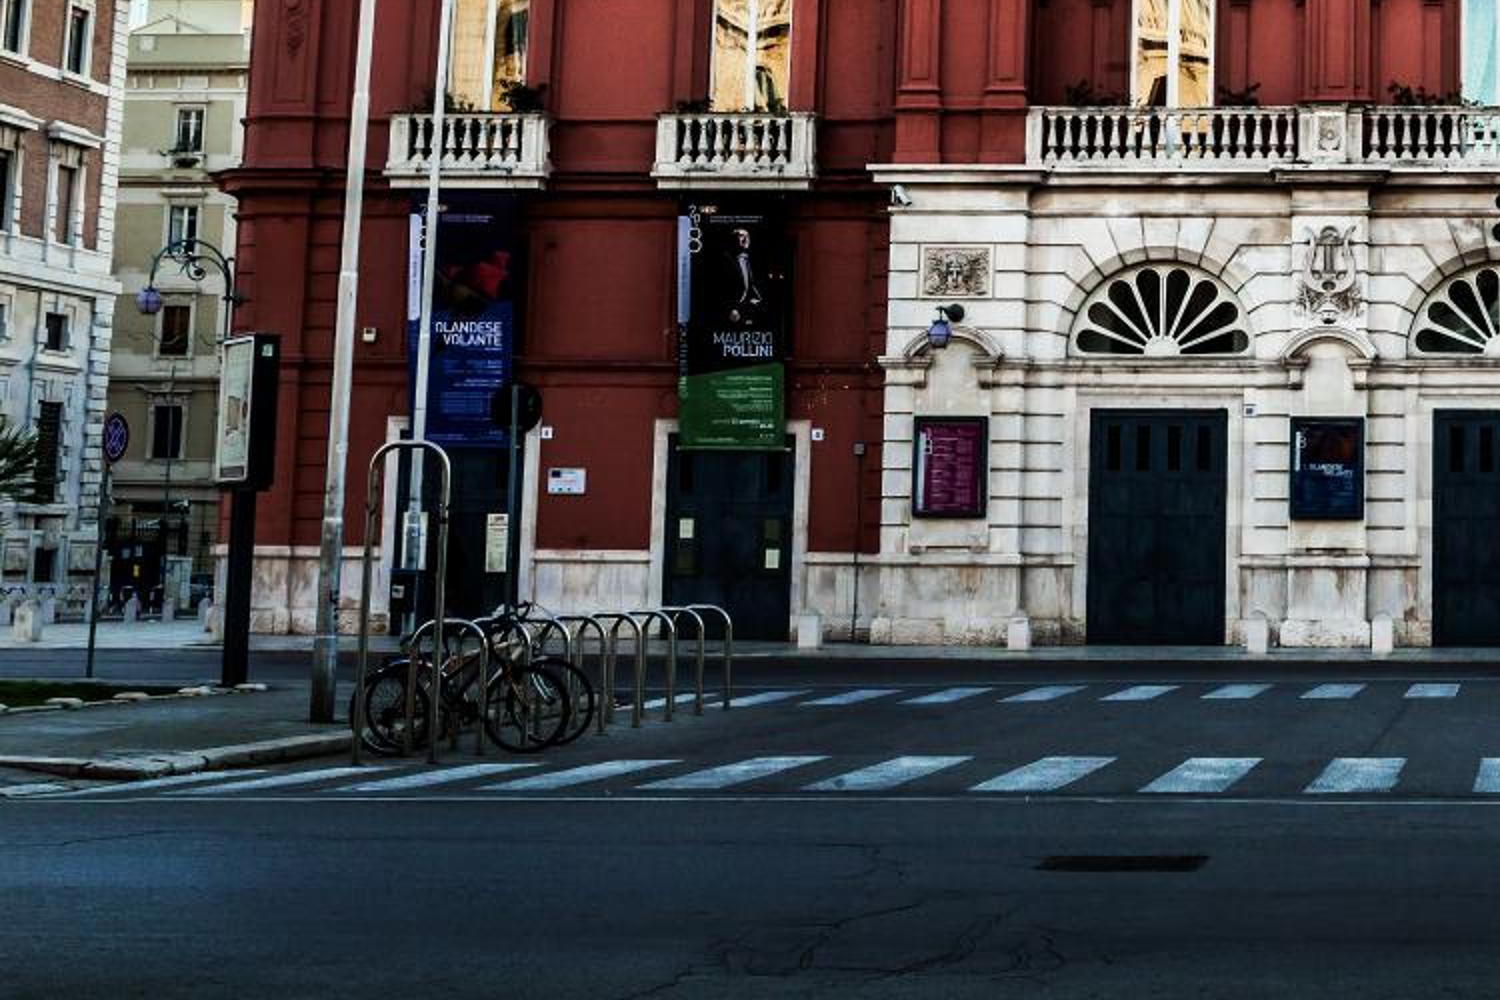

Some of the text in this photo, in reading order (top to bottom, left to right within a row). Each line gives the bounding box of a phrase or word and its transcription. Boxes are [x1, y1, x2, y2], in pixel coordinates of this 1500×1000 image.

[435, 321, 503, 334] OLANDESE
[443, 334, 503, 347] VOLANTE
[713, 331, 773, 344] MAURIZIO
[723, 344, 773, 357] POLLINI
